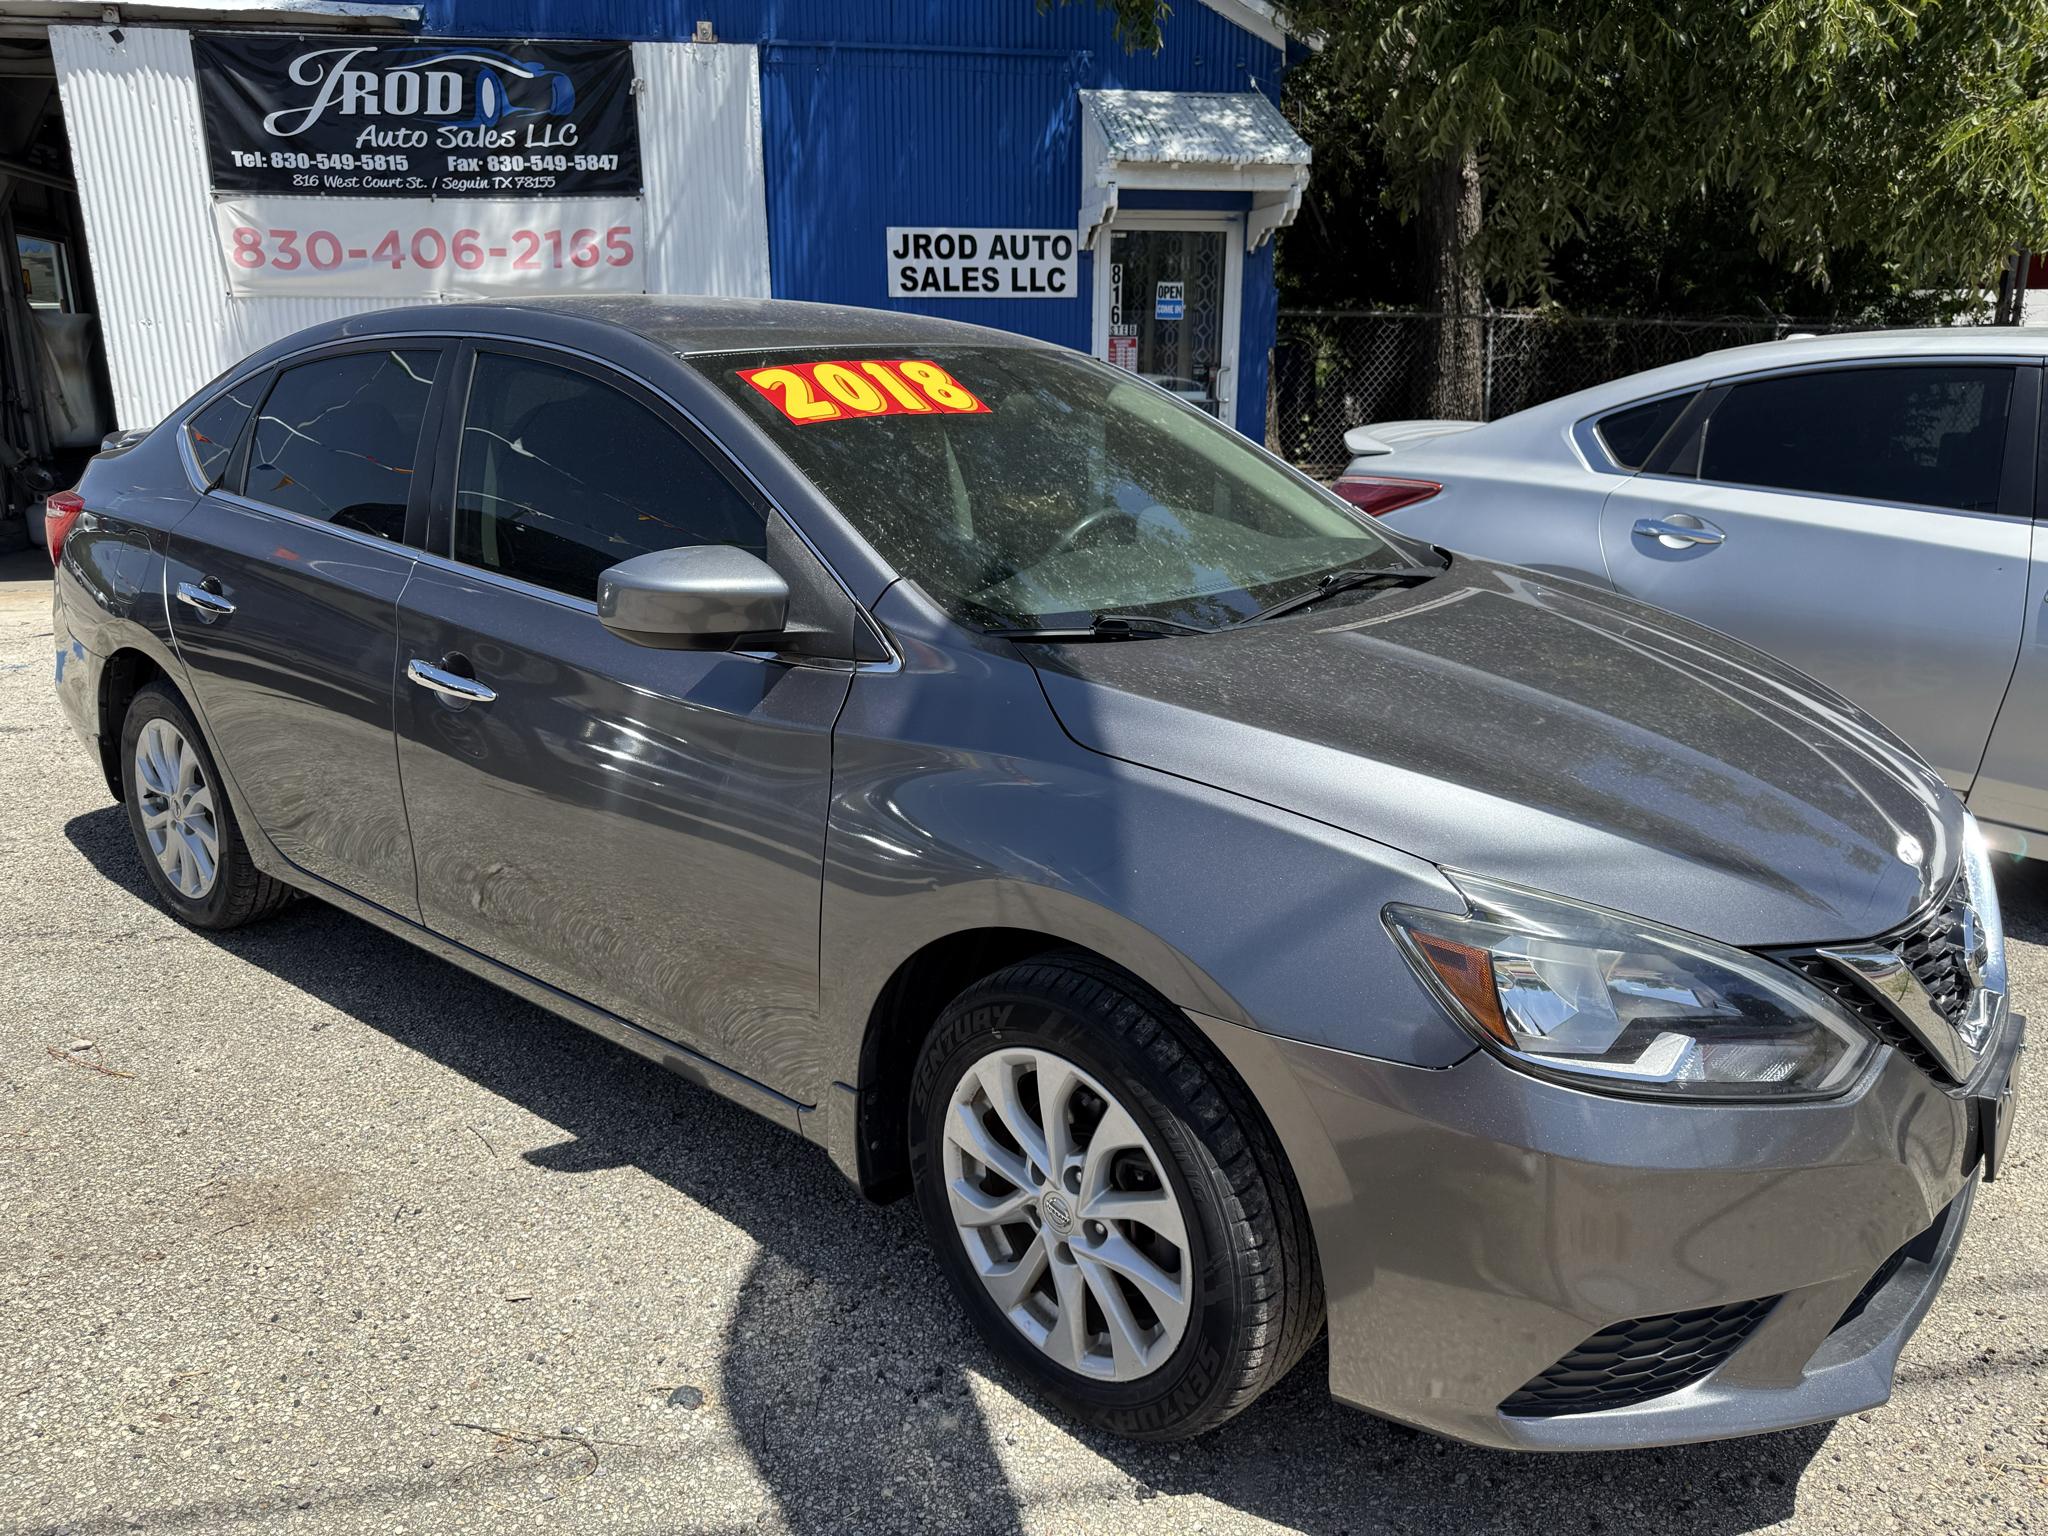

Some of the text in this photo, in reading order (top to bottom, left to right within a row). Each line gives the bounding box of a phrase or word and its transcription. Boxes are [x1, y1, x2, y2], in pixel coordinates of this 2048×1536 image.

[263, 46, 463, 137] JROD
[356, 123, 578, 149] Auto Sales LLC
[231, 151, 409, 171] Tel: 830-549-5815
[487, 155, 619, 172] 830-549-5847
[293, 174, 319, 187] 816
[323, 175, 360, 188] West
[363, 176, 403, 188] Court
[406, 176, 428, 189] St.
[442, 177, 490, 191] Seguin
[492, 176, 513, 189] TX
[514, 176, 556, 189] 78155
[232, 225, 634, 271] 830-406-2165
[893, 233, 1072, 260] JROD AUTO
[900, 266, 1066, 293] SALES LLC
[1157, 285, 1183, 299] OPEN
[751, 361, 978, 420] 2018
[914, 1005, 1017, 1116] SENTURY
